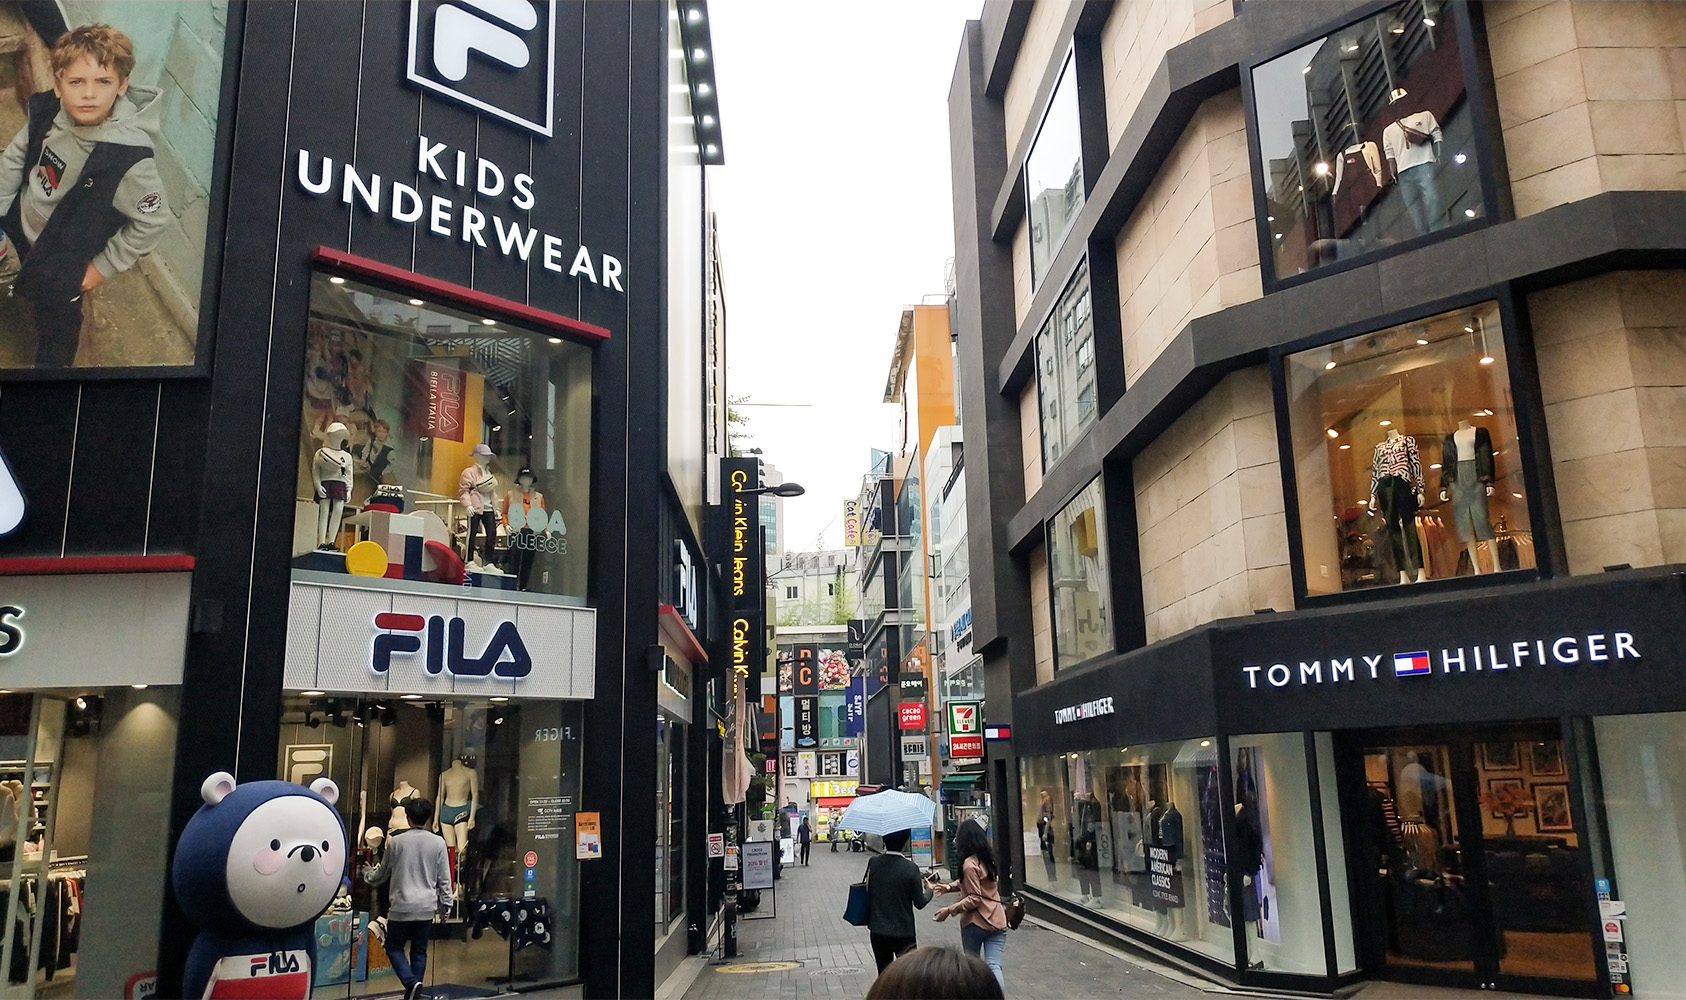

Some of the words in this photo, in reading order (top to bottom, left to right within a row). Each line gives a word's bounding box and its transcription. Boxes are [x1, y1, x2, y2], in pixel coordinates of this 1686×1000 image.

[44, 149, 65, 170] SNOW
[417, 135, 535, 210] KIDS
[299, 149, 625, 293] UNDERWEAR
[429, 371, 438, 400] BIELLA
[427, 401, 438, 430] ITALIA
[438, 372, 460, 434] FILA
[508, 503, 567, 535] BOA
[846, 501, 857, 516] Cat
[507, 532, 567, 554] FLEECE
[734, 517, 747, 552] Klein
[847, 518, 857, 539] Cafe
[733, 557, 748, 596] Jeans
[371, 612, 532, 679] FILA
[733, 618, 749, 664] Calvin
[1243, 654, 1383, 689] TOMMY
[1441, 631, 1642, 673] HILFIGER
[801, 699, 812, 736] 멀티방
[854, 695, 863, 716] SJYP
[902, 714, 921, 722] green
[1054, 706, 1077, 725] TOMMY
[1082, 696, 1115, 719] HILFIGER
[1149, 847, 1169, 860] MODERN
[1150, 860, 1174, 876] AMERICAN
[1151, 874, 1171, 889] CLASSICS
[250, 951, 300, 977] FILA
